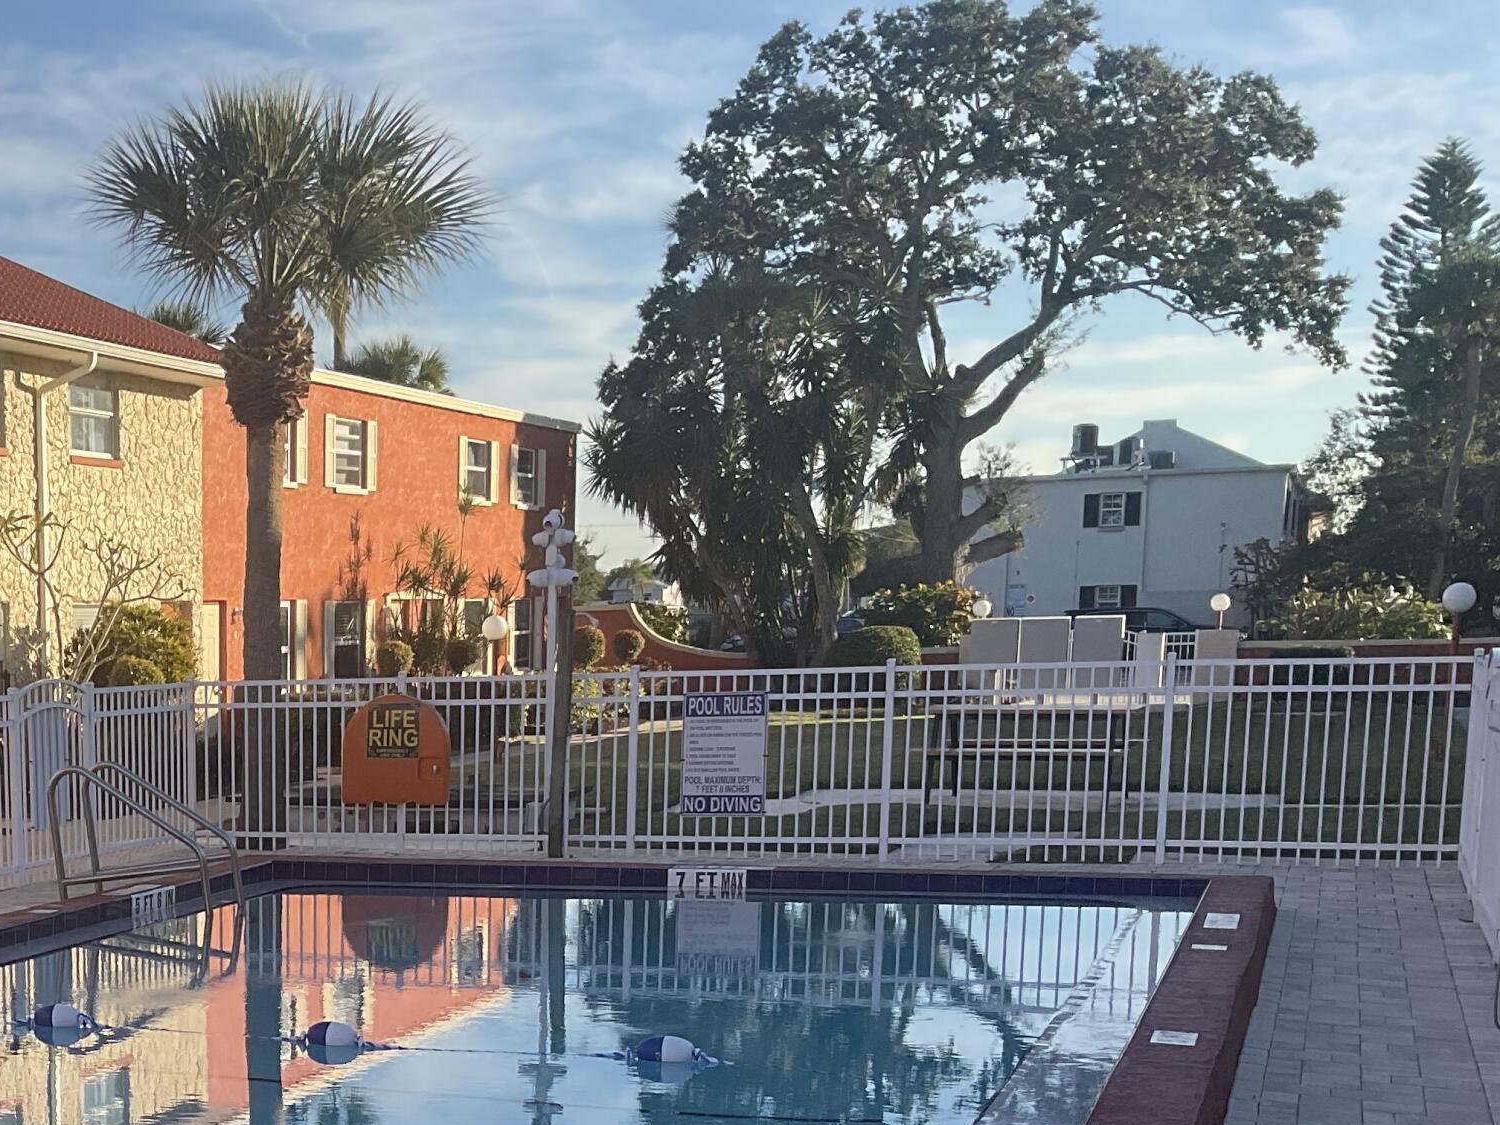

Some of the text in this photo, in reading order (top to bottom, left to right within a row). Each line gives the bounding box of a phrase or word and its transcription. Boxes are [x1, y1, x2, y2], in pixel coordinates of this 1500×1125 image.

[688, 696, 762, 716] POOL RULES
[372, 709, 416, 728] LIFE
[368, 728, 419, 748] RING
[684, 776, 703, 785] POOL
[704, 776, 736, 785] MAXIMUM
[701, 785, 718, 793] FEET
[724, 785, 750, 793] INCHES
[683, 797, 761, 812] NO DIVING
[675, 872, 686, 889] 7
[721, 872, 744, 889] MAX
[135, 898, 140, 914] 5
